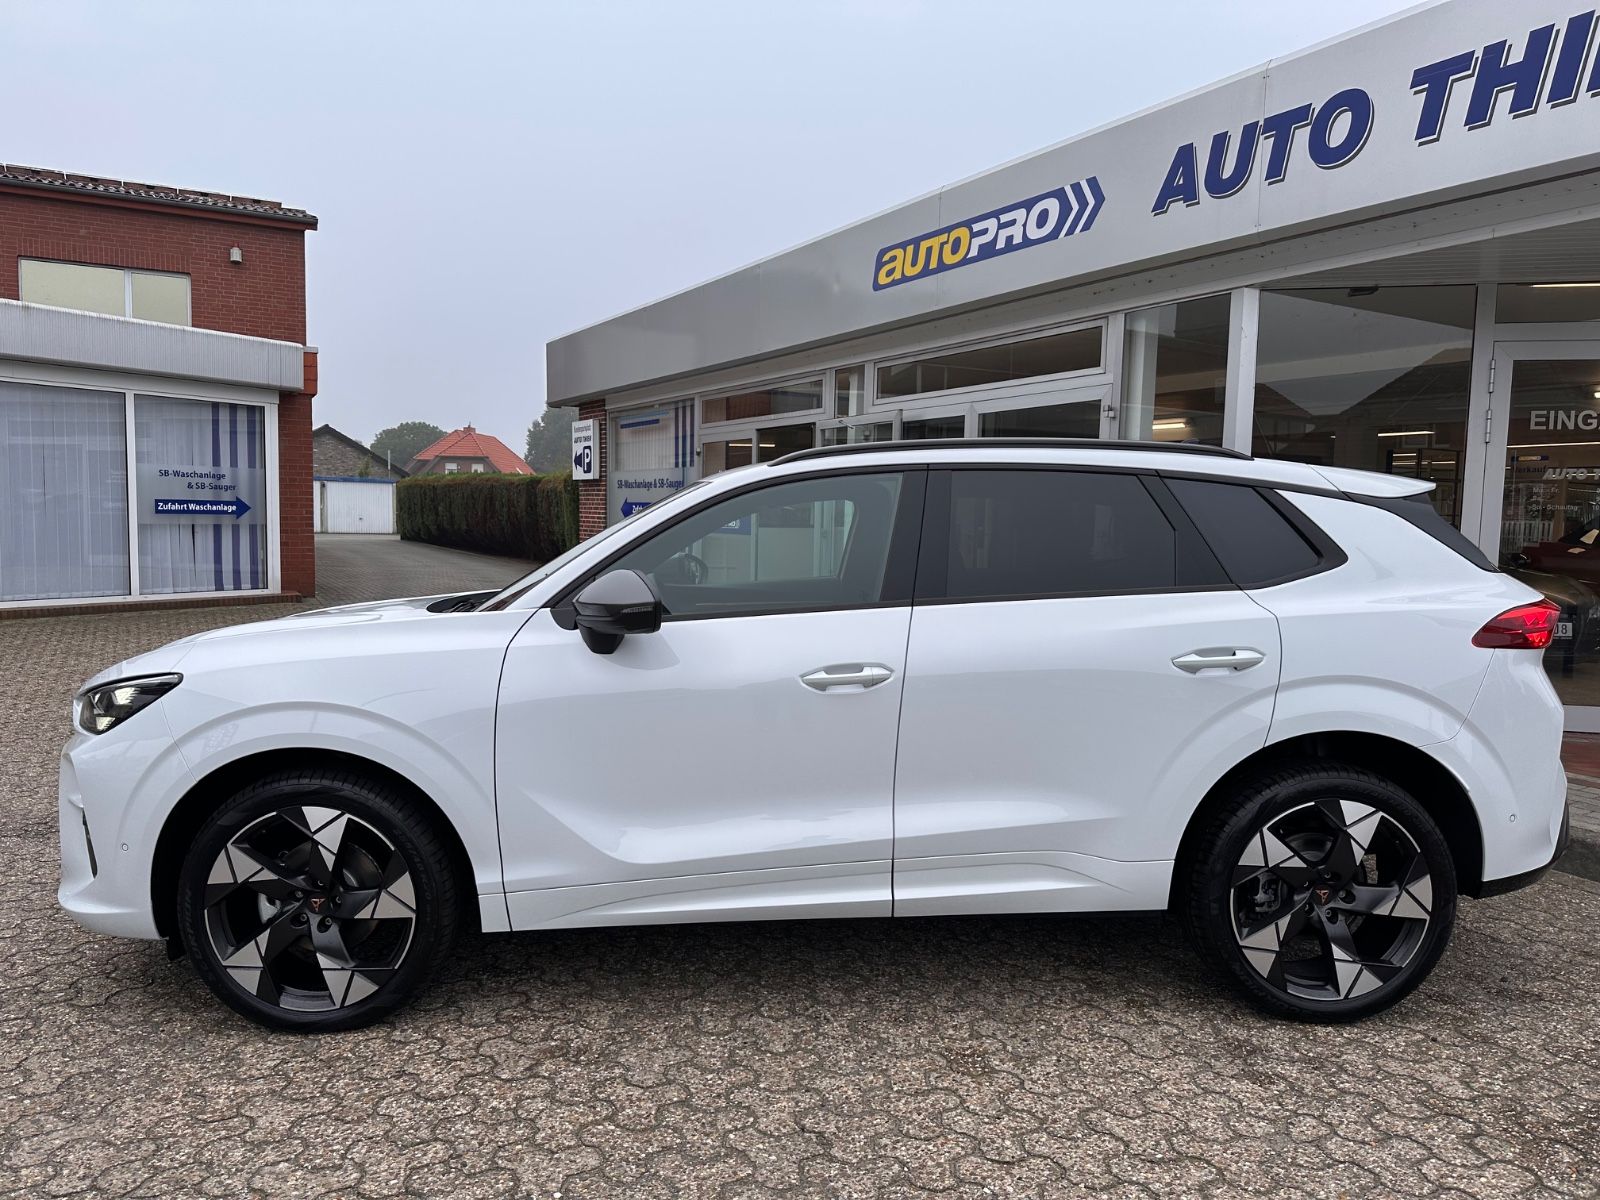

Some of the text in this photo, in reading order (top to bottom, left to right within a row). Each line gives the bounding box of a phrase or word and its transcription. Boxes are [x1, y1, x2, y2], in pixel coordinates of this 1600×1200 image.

[1152, 9, 1600, 216] AUTO THI
[1530, 410, 1600, 431] EING
[158, 470, 226, 480] SB-Waschanlage
[195, 482, 236, 491] SB-Sauger
[617, 479, 652, 491] SB-Waschanlage
[189, 503, 237, 512] Waschanlage
